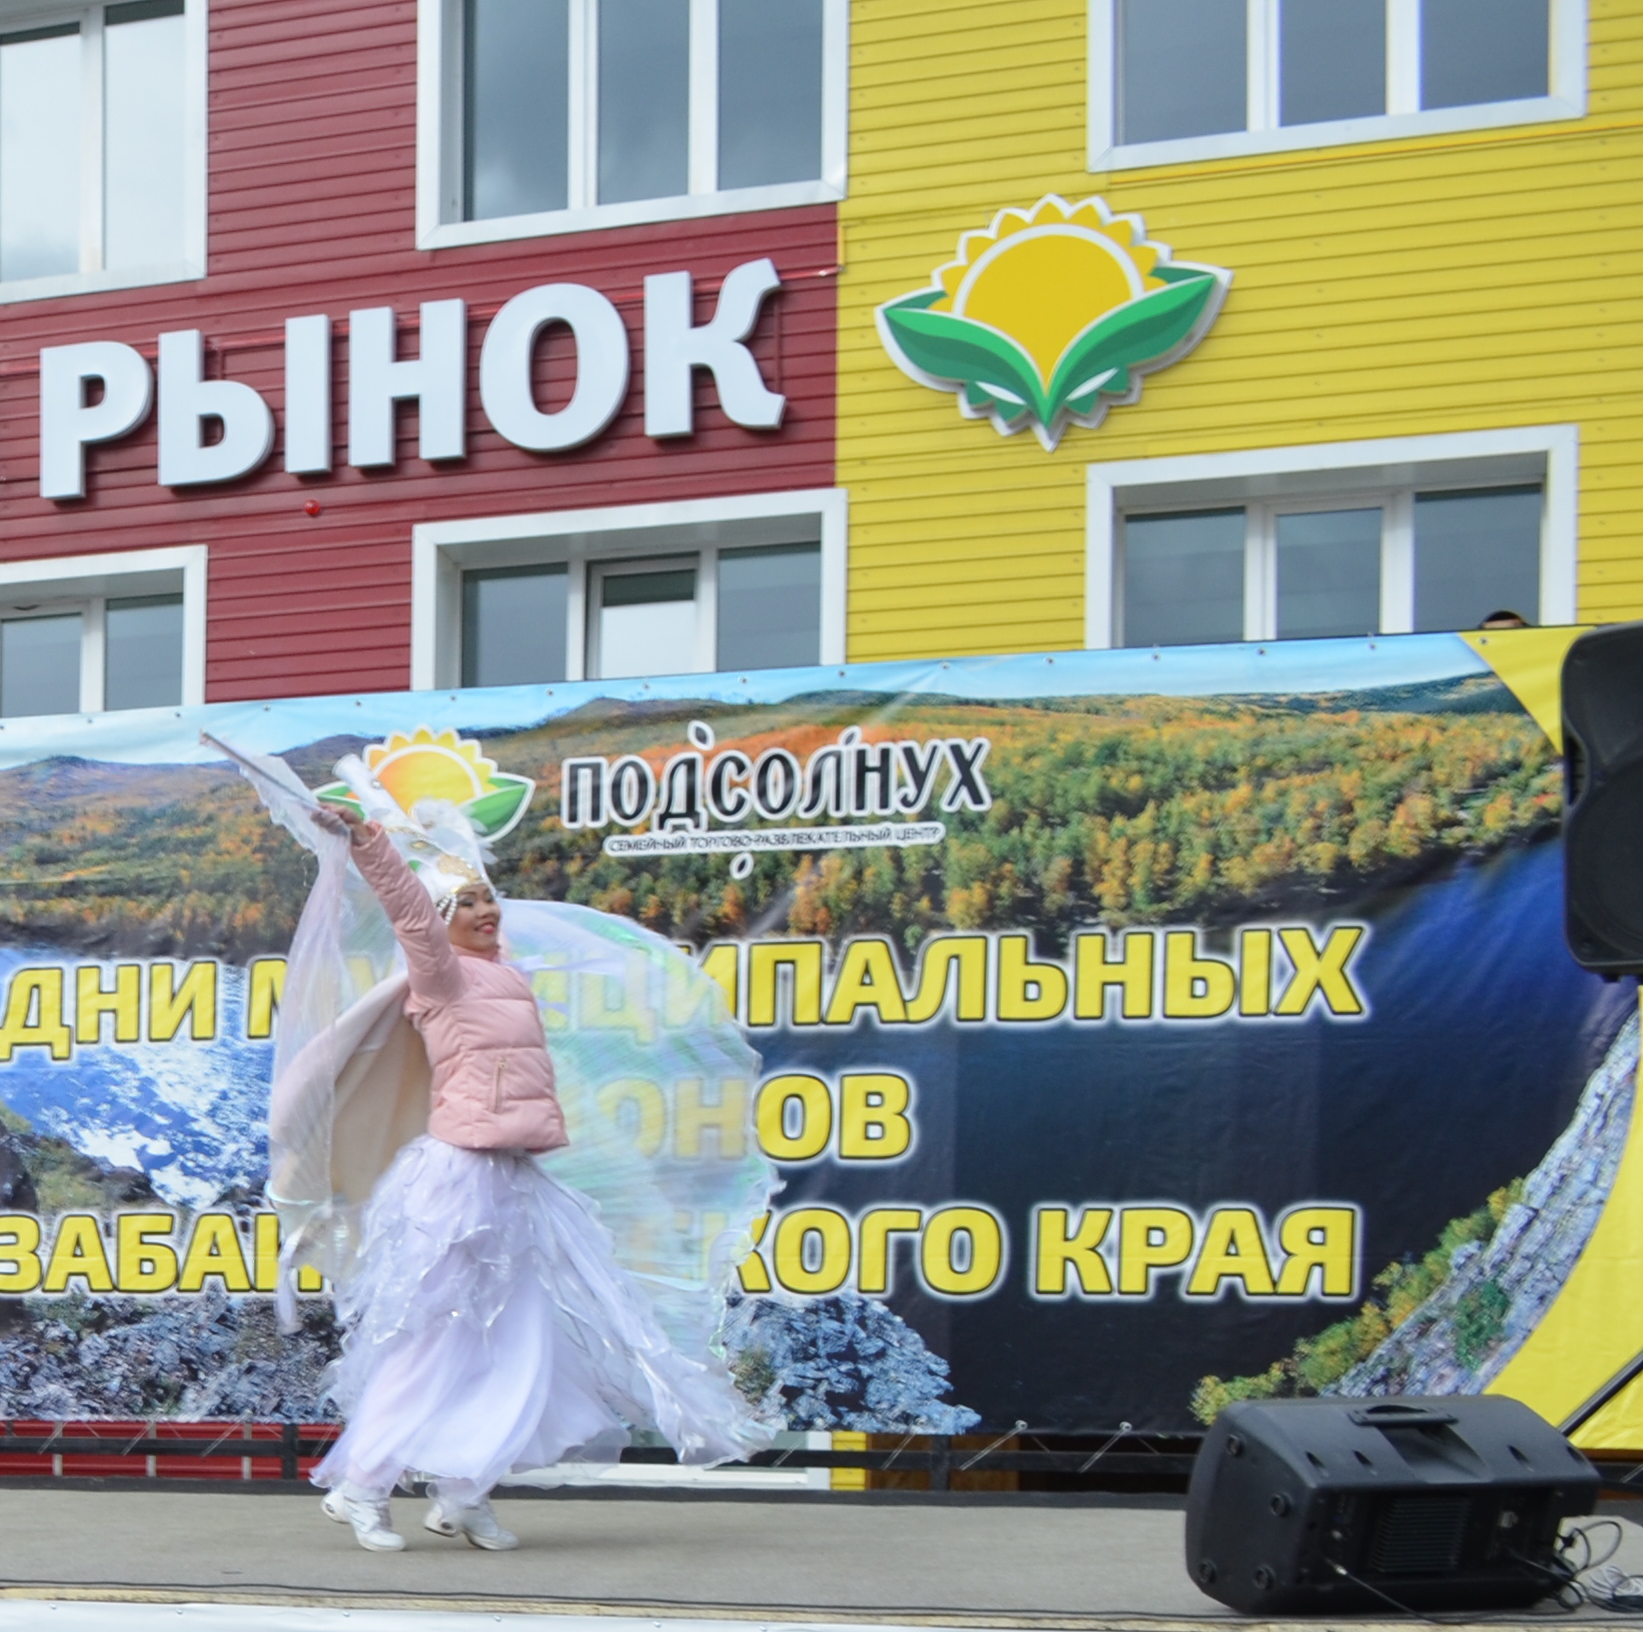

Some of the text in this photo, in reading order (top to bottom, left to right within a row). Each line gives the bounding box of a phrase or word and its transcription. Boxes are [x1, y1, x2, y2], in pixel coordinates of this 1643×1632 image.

[39, 257, 785, 500] РЫНОК
[563, 738, 990, 832] ПОДСОЛНУХ
[1035, 1206, 1355, 1297] КРАЯ
